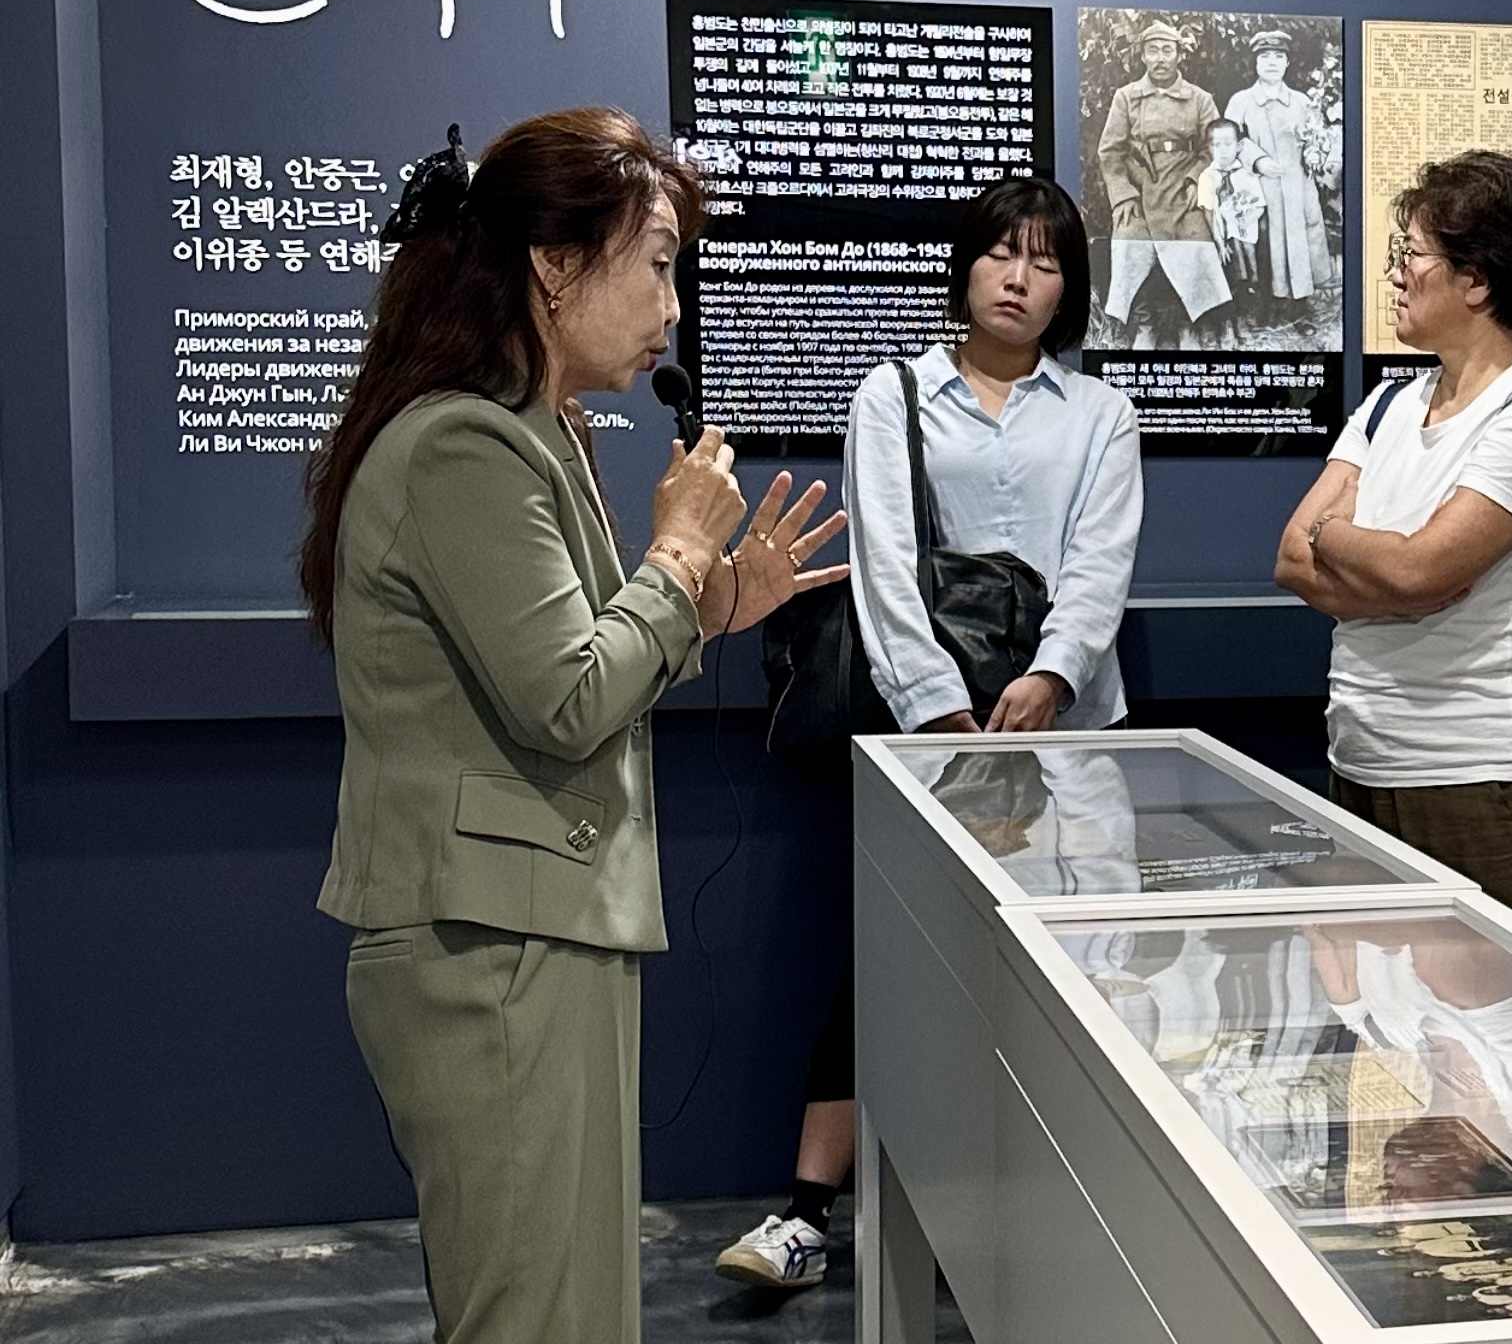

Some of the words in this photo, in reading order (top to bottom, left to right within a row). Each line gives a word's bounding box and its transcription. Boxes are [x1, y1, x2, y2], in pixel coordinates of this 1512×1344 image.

[802, 80, 825, 94] 크고
[170, 154, 273, 191] 최재형,
[284, 156, 388, 194] 안중근,
[172, 195, 201, 230] 김
[212, 195, 379, 234] 알렉산드라,
[173, 237, 270, 272] 이위종
[276, 240, 311, 272] 등
[699, 238, 768, 258] Генерал
[770, 240, 803, 255] Хон
[805, 241, 839, 256] Бом
[841, 241, 864, 259] До
[867, 241, 953, 259] (1868~1943
[699, 257, 820, 274] вооруженного
[823, 258, 946, 273] антияпонского
[174, 309, 309, 332] Приморский
[314, 310, 369, 333] край,
[174, 337, 283, 356] движения
[287, 339, 310, 353] за
[176, 359, 260, 382] Лидеры
[177, 384, 205, 402] Ан
[209, 385, 266, 407] Джун
[271, 385, 317, 406] Гын,
[178, 410, 222, 427] Ким
[178, 434, 209, 452] Ли
[214, 435, 242, 452] Ви
[246, 435, 304, 453] Чжон
